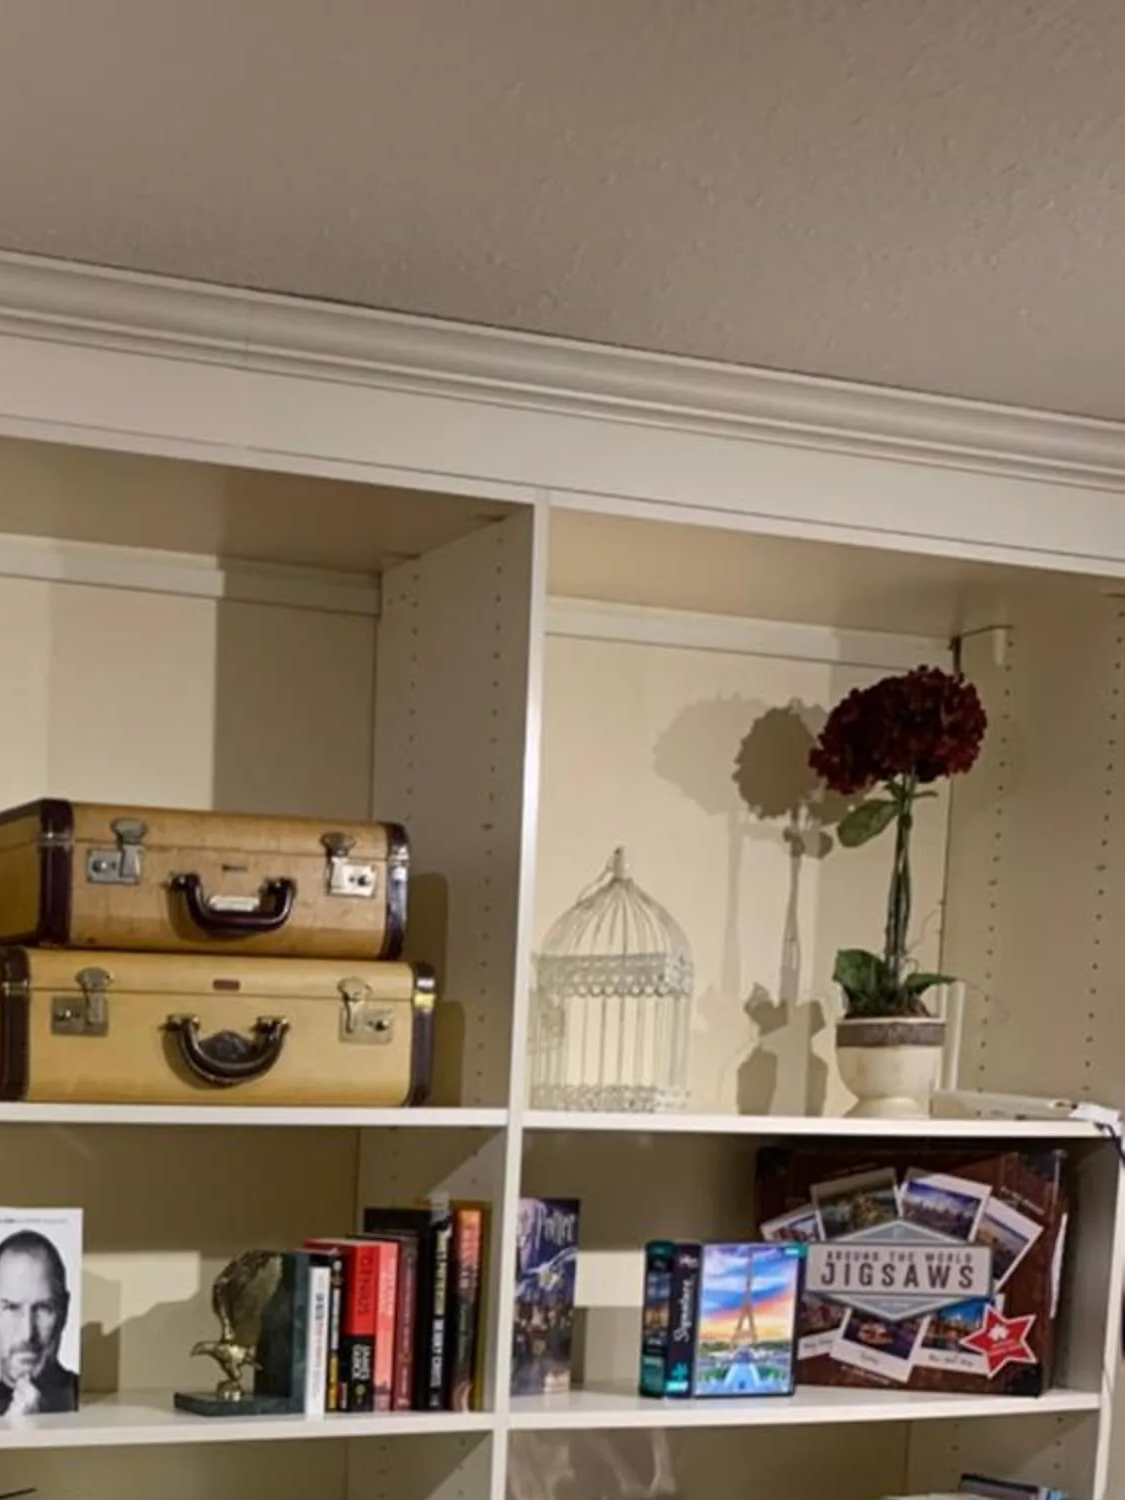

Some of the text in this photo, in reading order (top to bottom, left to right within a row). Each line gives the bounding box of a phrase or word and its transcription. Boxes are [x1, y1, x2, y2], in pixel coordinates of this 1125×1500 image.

[889, 1252, 915, 1262] THE
[925, 1252, 972, 1264] WORLD
[821, 1262, 975, 1289] JIGSAWS
